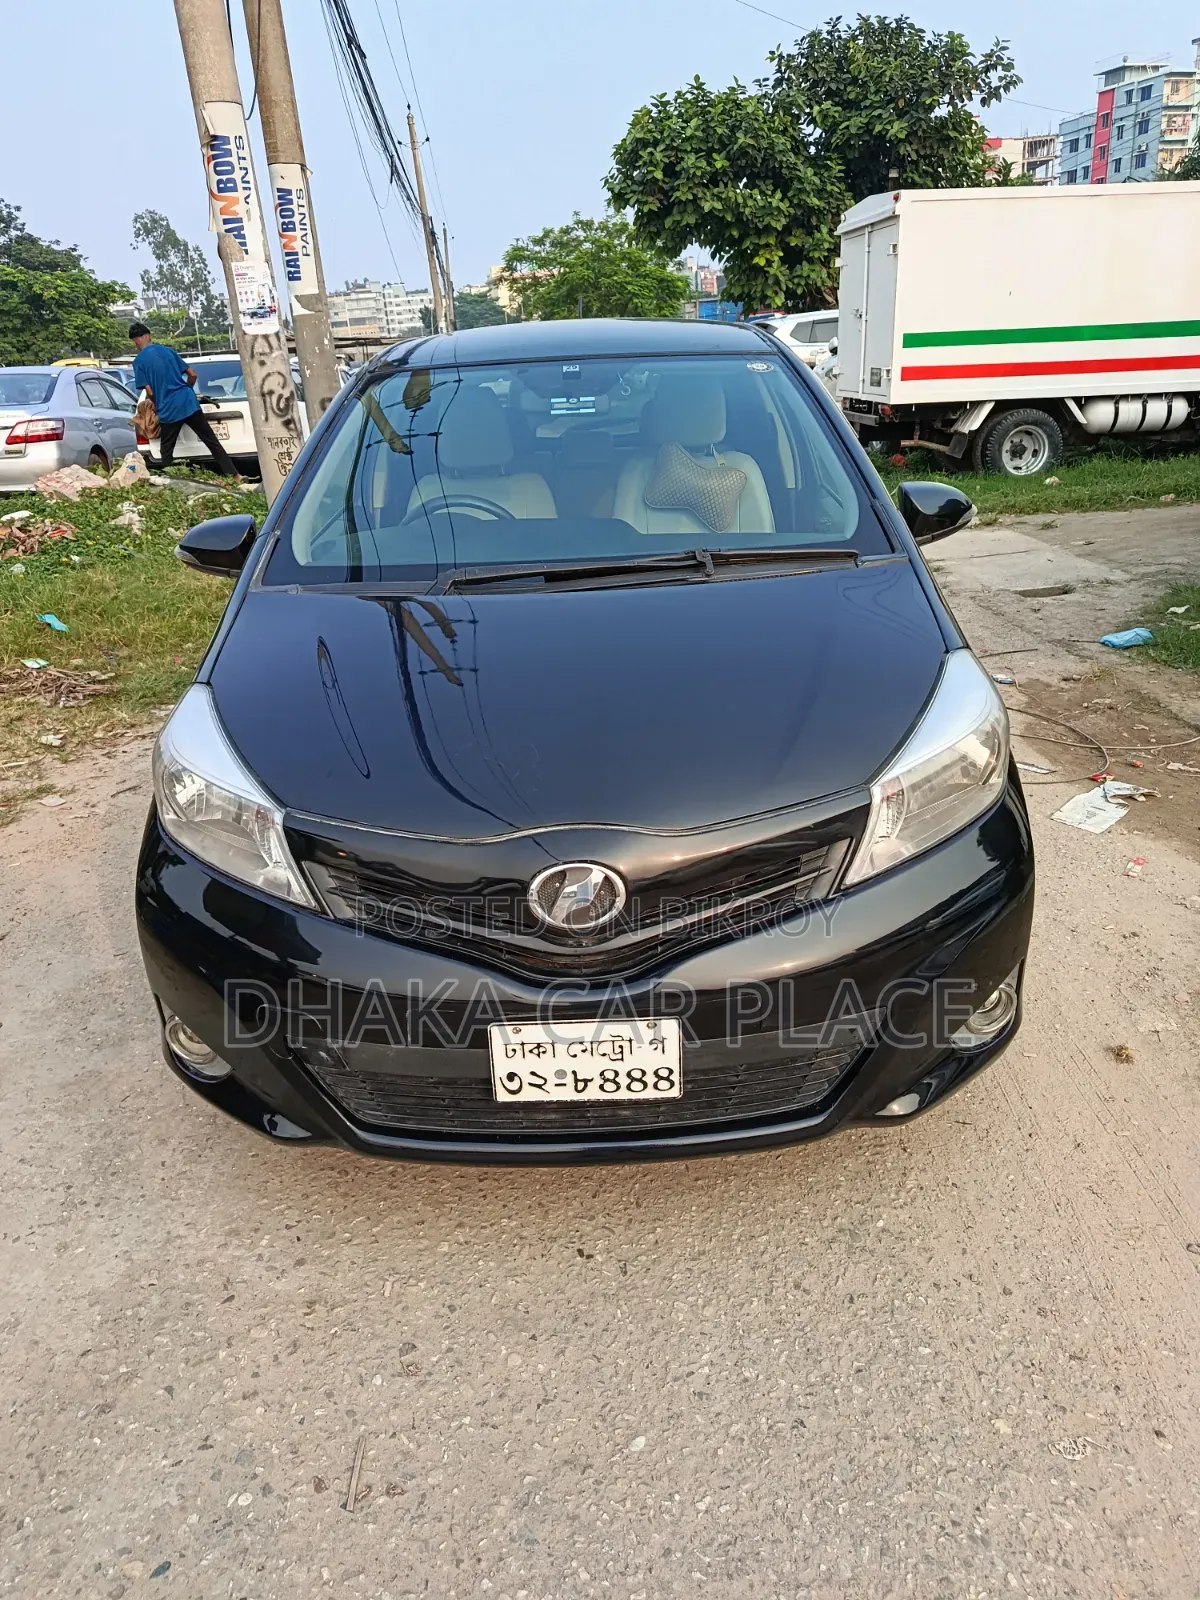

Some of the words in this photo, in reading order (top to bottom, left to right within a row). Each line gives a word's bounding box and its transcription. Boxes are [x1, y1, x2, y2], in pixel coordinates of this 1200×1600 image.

[207, 134, 249, 255] AINBOW
[295, 188, 310, 257] PAINTS
[274, 187, 301, 281] RAINBOW
[500, 1066, 675, 1095] ৩২-৮৪৪৪
[503, 1041, 556, 1059] ঢাকা
